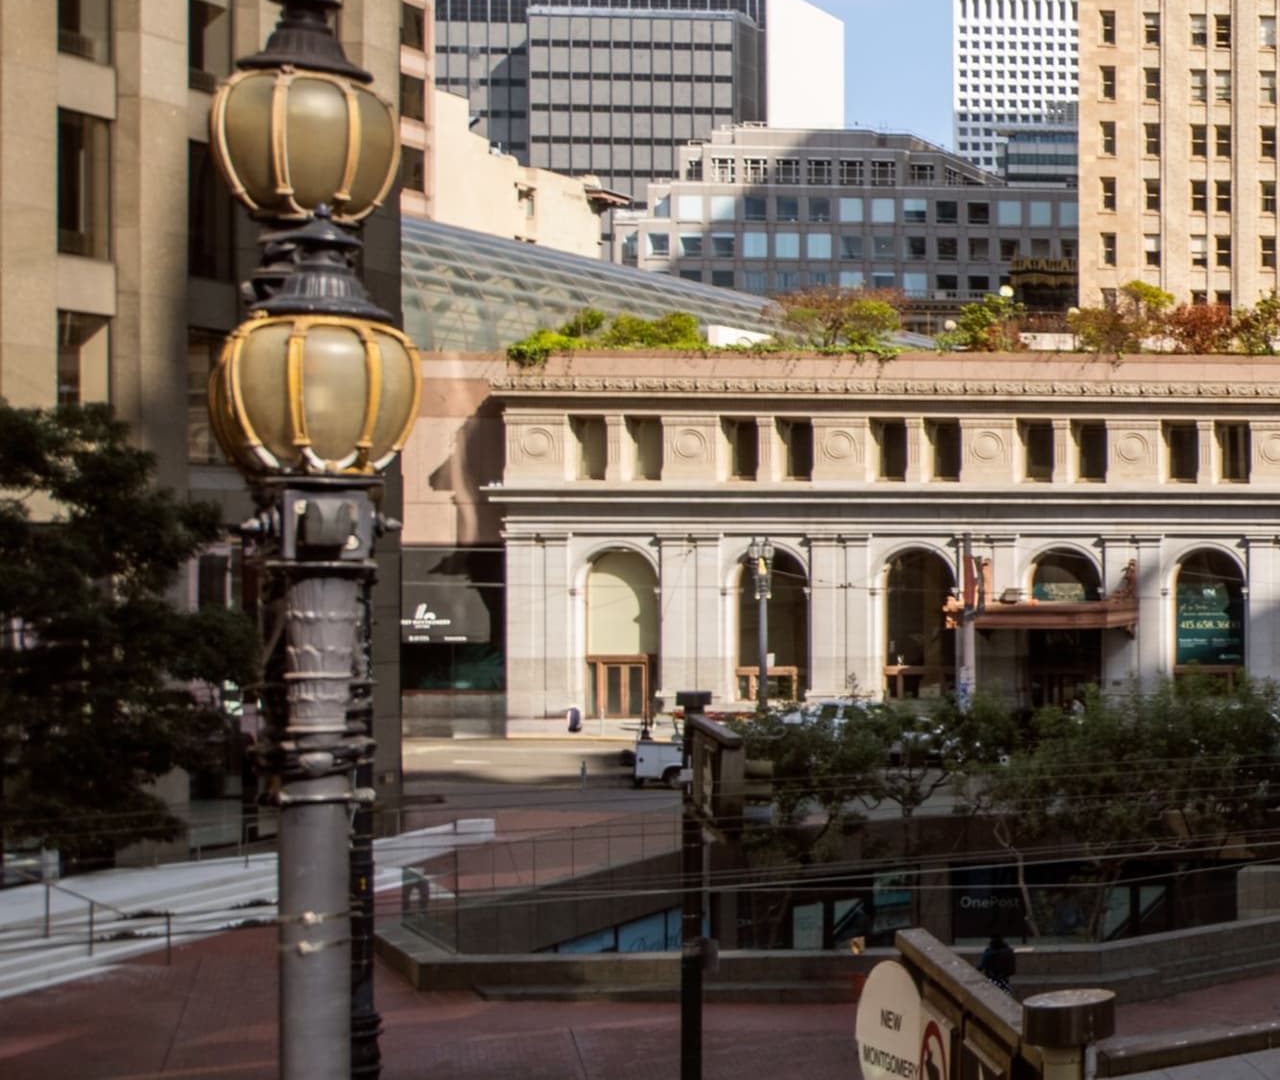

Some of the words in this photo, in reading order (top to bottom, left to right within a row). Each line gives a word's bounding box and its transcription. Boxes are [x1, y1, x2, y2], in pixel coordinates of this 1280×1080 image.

[960, 896, 1020, 909] OnePost
[881, 1008, 902, 1032] NEW
[863, 1043, 920, 1079] MONTGOMERY
